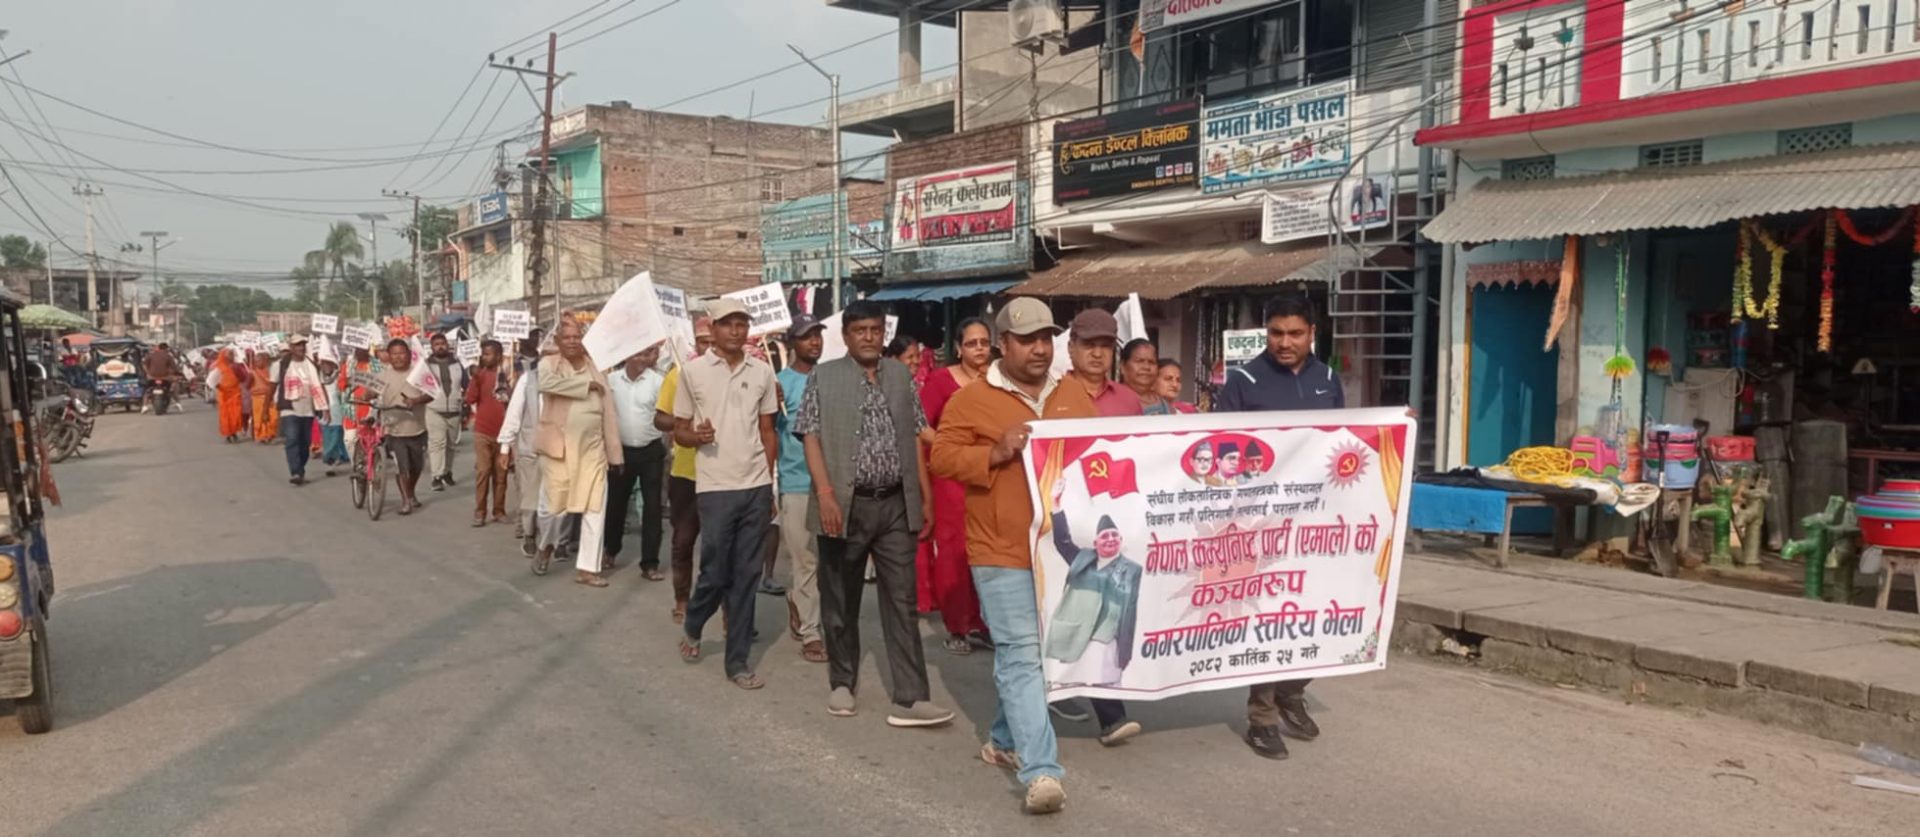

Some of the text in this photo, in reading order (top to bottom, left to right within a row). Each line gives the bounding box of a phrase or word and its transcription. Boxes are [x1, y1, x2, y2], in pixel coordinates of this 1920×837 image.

[1206, 113, 1252, 140] ममता
[1297, 94, 1346, 123] पसल
[1112, 159, 1129, 169] Smile
[956, 176, 1012, 203] कलेक्सन
[1257, 331, 1267, 348] डे
[1146, 489, 1175, 507] संघीय
[1283, 482, 1324, 497] संस्थागत
[1146, 511, 1176, 527] विकास
[1272, 501, 1302, 516] परास्त
[1146, 532, 1188, 575] नेपाल
[1261, 518, 1294, 558] पार्टी
[1295, 514, 1350, 557] (एमाले)
[1354, 514, 1380, 554] को
[1140, 599, 1366, 660] नगरपालिका स्तरिय भेला
[1189, 643, 1321, 676] २०८२ कार्तिक २५ गते
